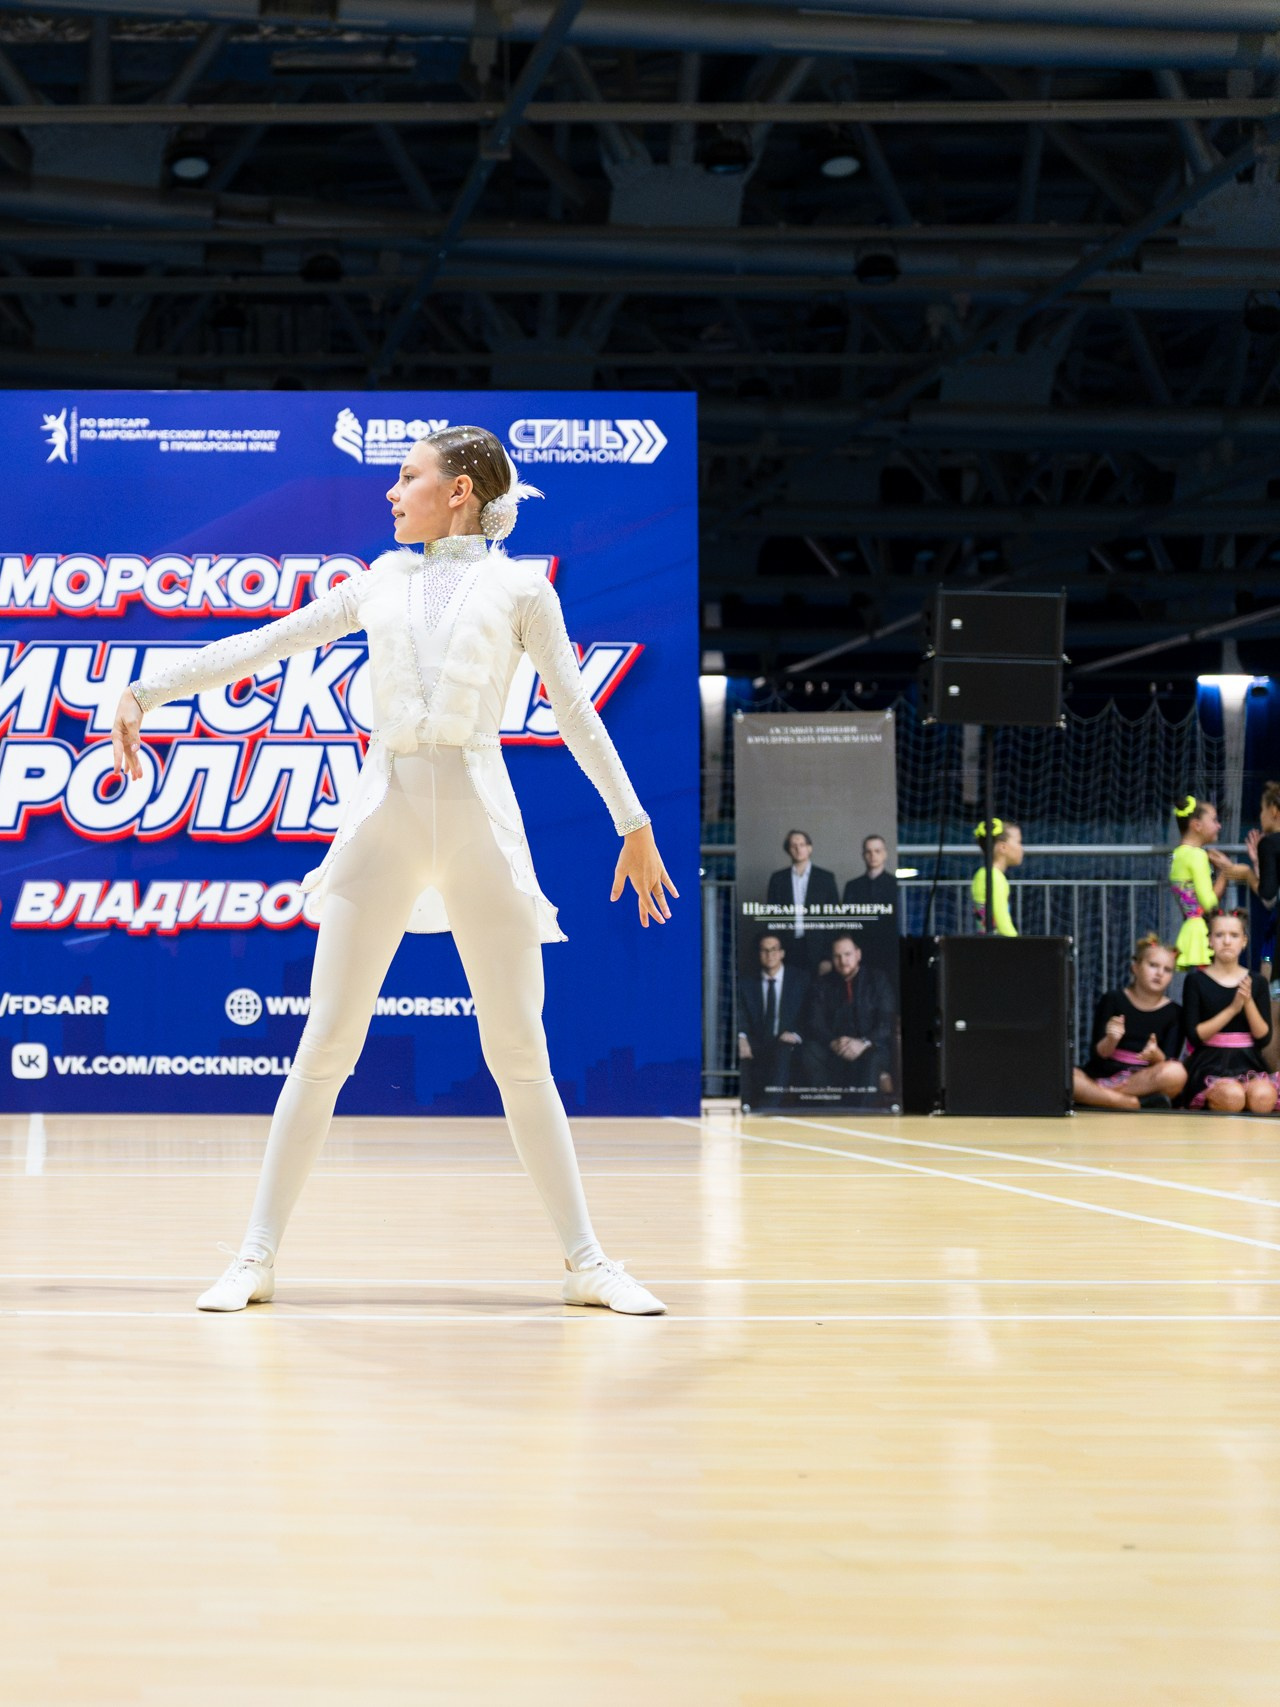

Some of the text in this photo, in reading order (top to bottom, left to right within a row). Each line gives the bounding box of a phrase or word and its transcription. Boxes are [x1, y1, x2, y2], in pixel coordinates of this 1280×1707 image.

[80, 429, 98, 440] ПО
[508, 418, 624, 449] СТАНЬ
[510, 449, 625, 464] ЧЕМПИОНОМ
[13, 879, 323, 932] ВЛАДИВО
